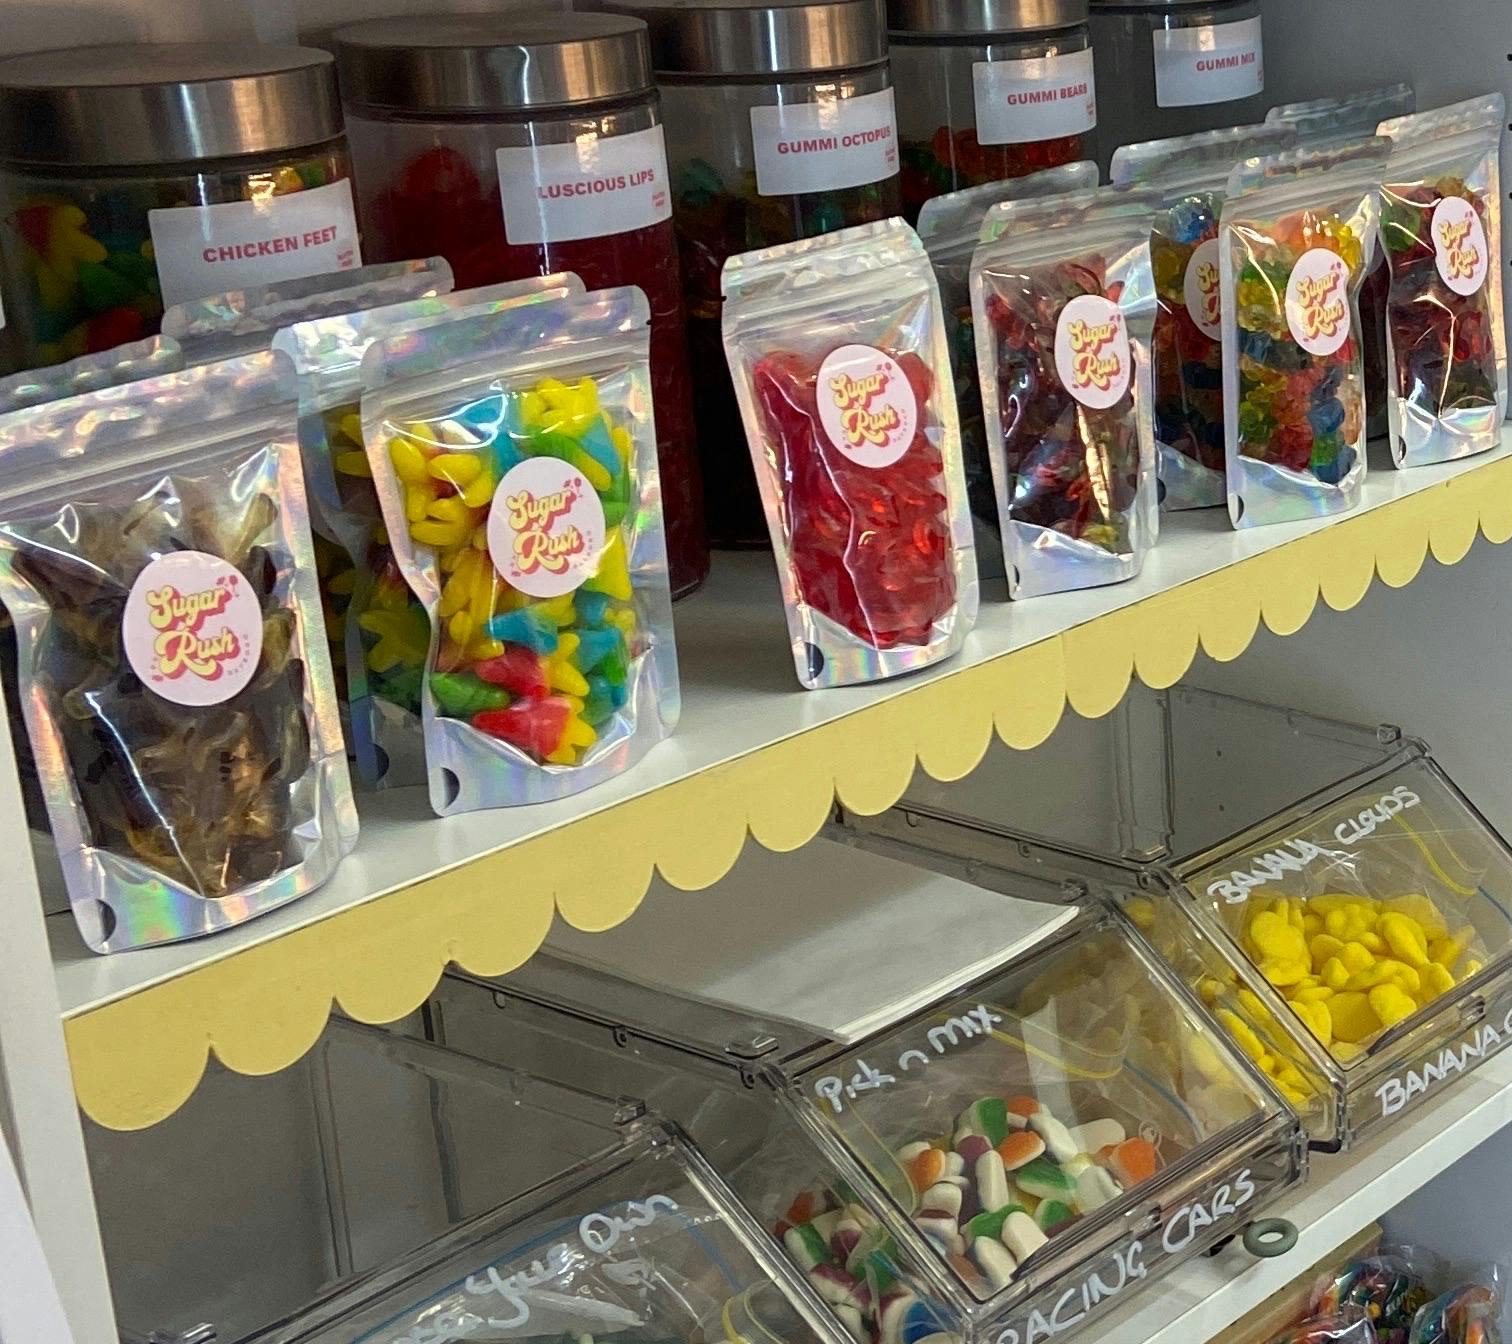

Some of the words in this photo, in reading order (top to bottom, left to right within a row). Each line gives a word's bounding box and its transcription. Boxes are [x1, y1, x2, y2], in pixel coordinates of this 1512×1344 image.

[1196, 56, 1239, 72] GUMMI
[1240, 51, 1256, 68] MIX
[1006, 89, 1057, 106] GUMMI
[1060, 82, 1088, 100] BEARS
[777, 137, 838, 154] GUMMI
[842, 125, 891, 148] OCTOPUS
[537, 175, 627, 200] LUSCIOUS
[629, 167, 655, 186] LIPS
[202, 235, 298, 263] CHICKEN
[303, 224, 338, 246] FEET
[1296, 271, 1340, 307] Sugar
[1067, 318, 1118, 357] Sugar
[1302, 299, 1345, 340] Rush
[829, 369, 889, 410] Sugar
[1073, 349, 1121, 392] Rush
[841, 404, 901, 448] Rush
[506, 487, 577, 534] Sugar
[513, 524, 584, 575] Rush
[146, 585, 233, 632] Sugar
[154, 626, 241, 681] Rush
[1375, 1022, 1500, 1117] BANANA
[1162, 1166, 1256, 1255] CARS
